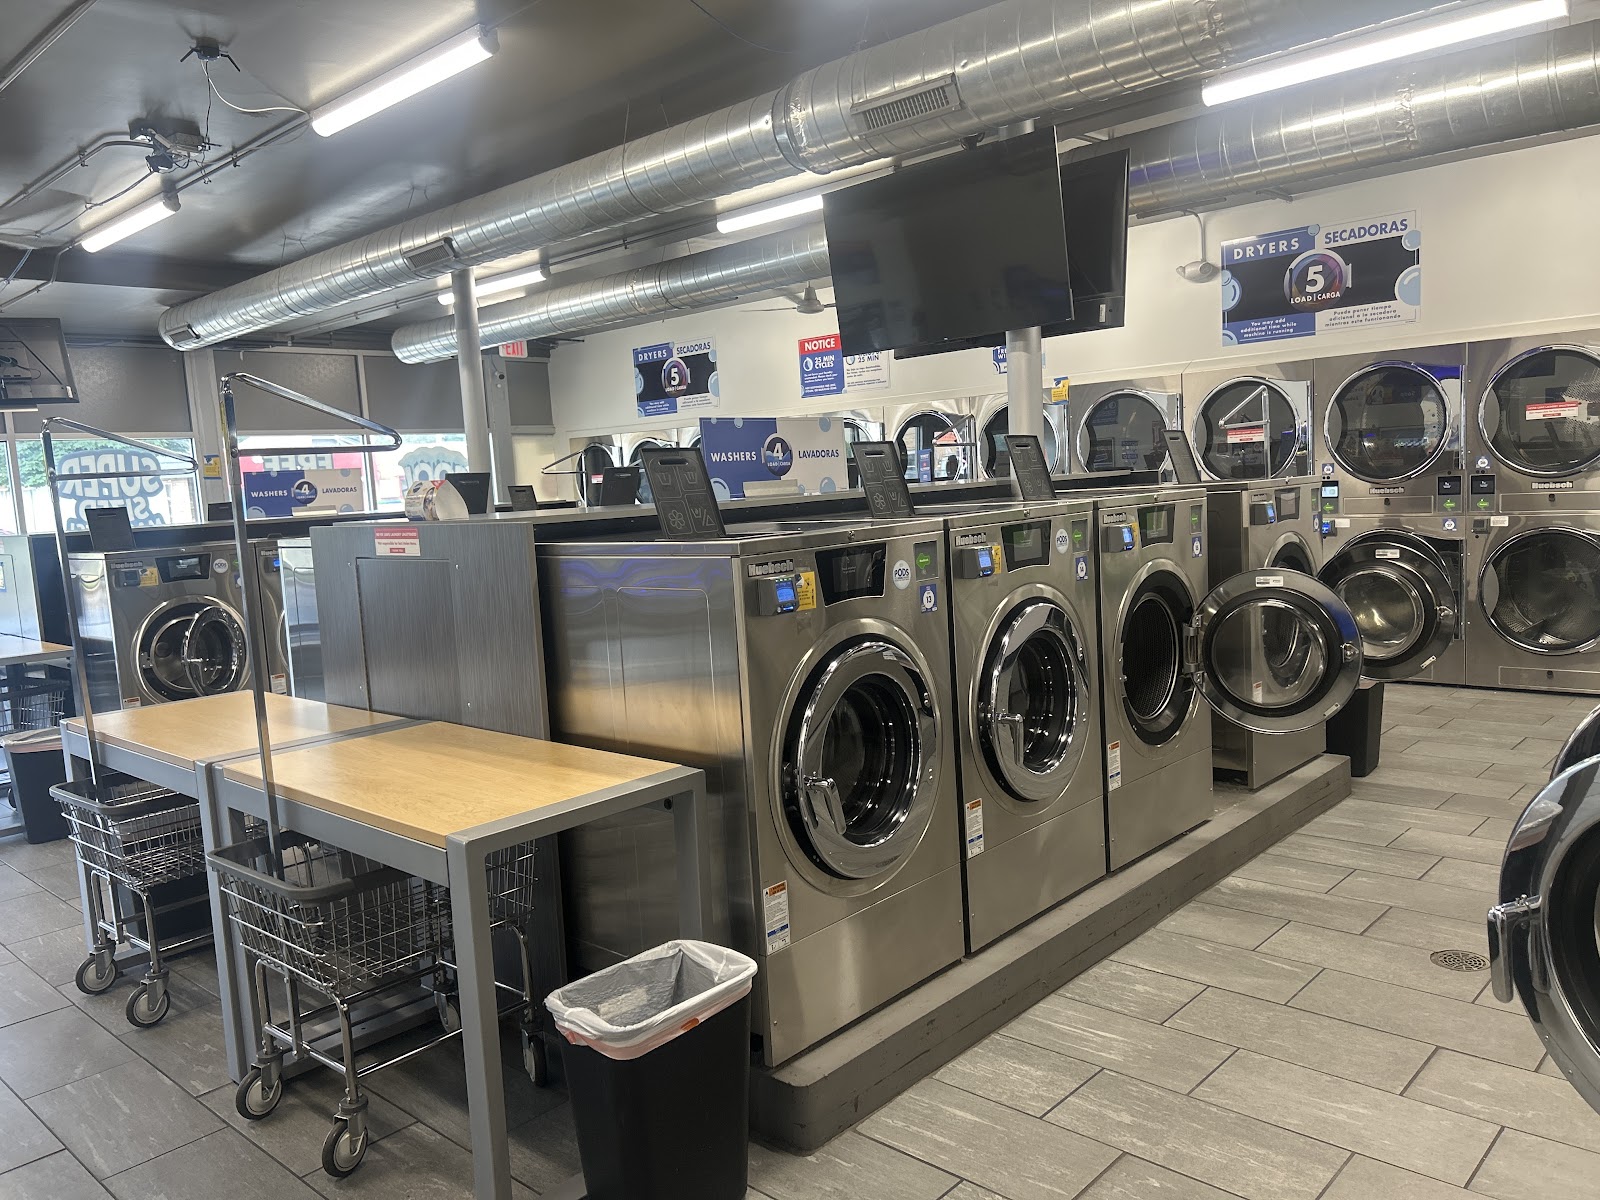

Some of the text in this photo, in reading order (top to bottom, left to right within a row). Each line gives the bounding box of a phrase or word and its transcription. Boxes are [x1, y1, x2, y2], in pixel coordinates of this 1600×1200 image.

[1233, 218, 1408, 260] DRYERS SECADORAS
[1305, 265, 1325, 293] 5
[1290, 291, 1341, 304] LOAD CARGA
[505, 340, 524, 356] EXIT
[638, 341, 711, 362] DRYERS SECADORAS
[804, 337, 836, 352] NOTICE
[822, 354, 835, 362] MIN
[814, 361, 834, 370] CYCLES
[670, 367, 680, 386] 5
[710, 449, 840, 463] WASHERS LAVADORAS
[773, 442, 784, 461] 4
[250, 489, 288, 498] WASHERS
[321, 486, 358, 494] LAVADORAS
[301, 484, 310, 495] 4
[1531, 481, 1573, 489] Huebsch
[955, 532, 987, 547] Huebsch
[748, 559, 794, 577] Huebsch
[894, 567, 910, 579] PODS
[926, 595, 932, 604] 13
